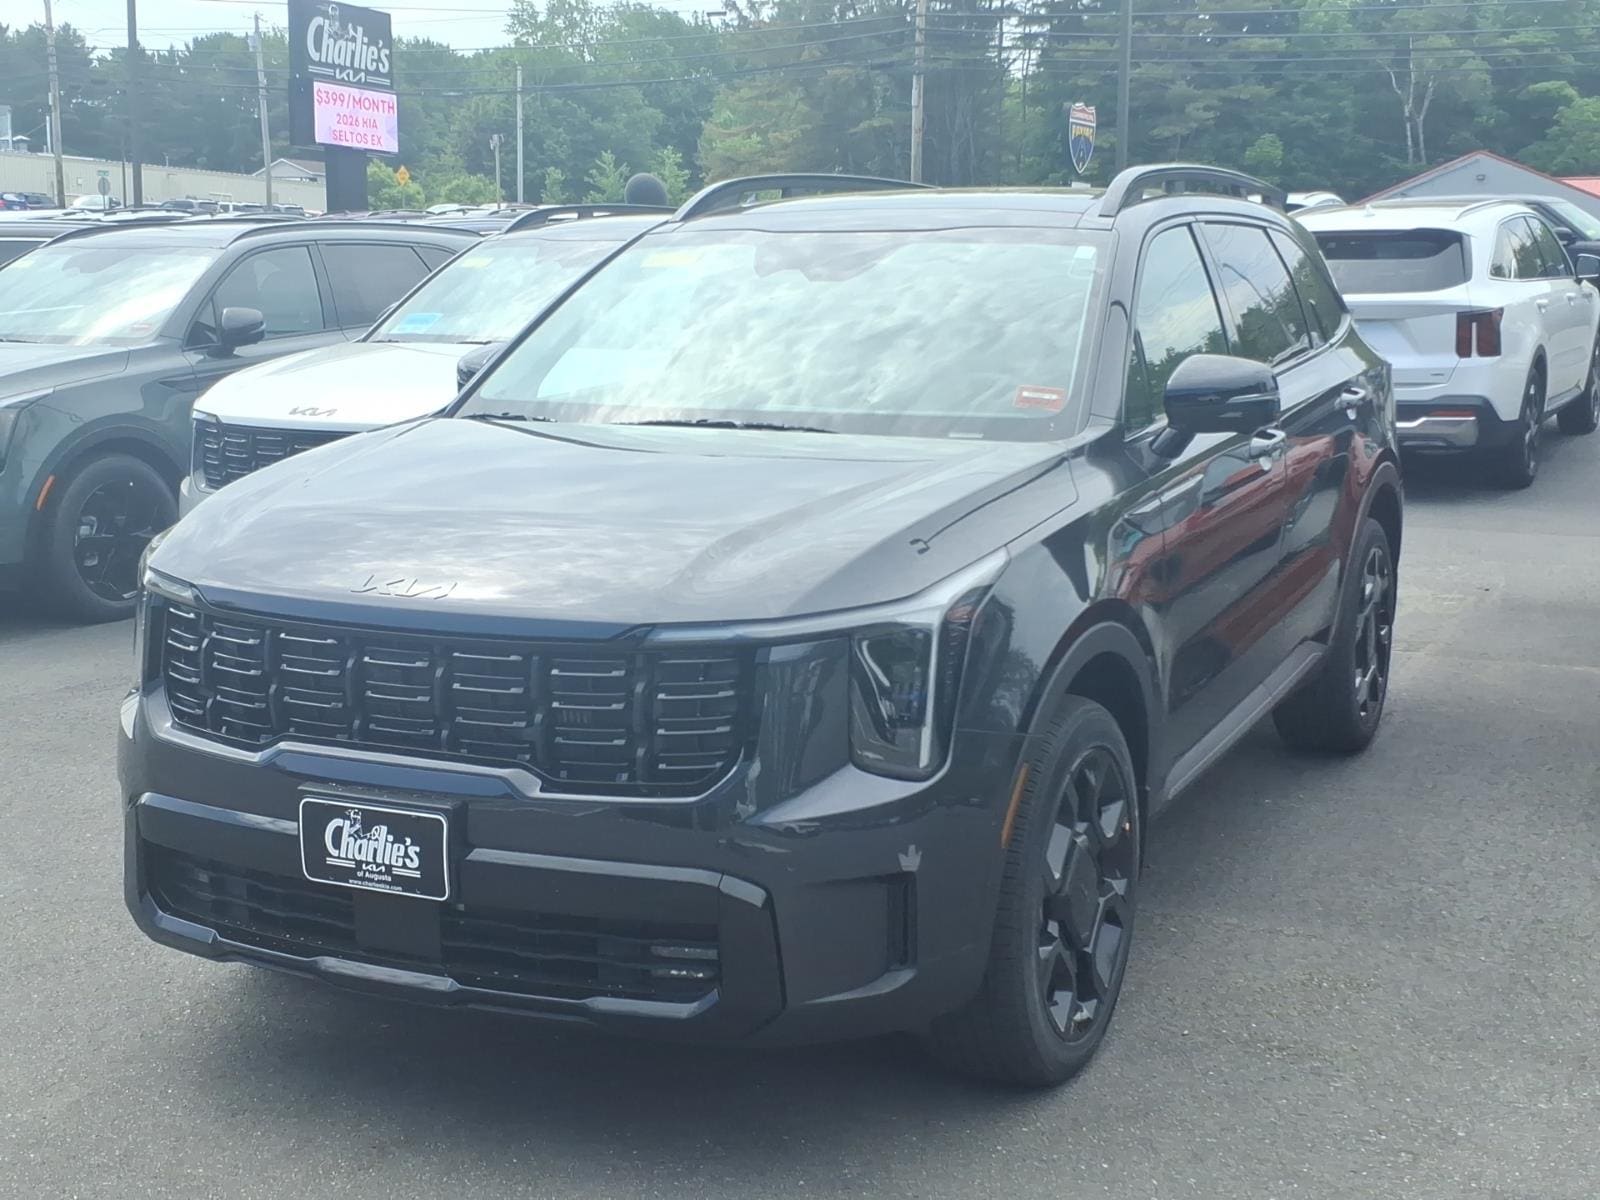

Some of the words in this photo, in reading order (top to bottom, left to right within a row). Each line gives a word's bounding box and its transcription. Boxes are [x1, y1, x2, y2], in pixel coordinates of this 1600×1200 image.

[307, 16, 390, 74] Charlie's
[316, 88, 396, 115] $399/MONTH
[336, 113, 360, 127] 2026
[332, 129, 369, 145] SELTOS
[371, 134, 383, 147] EX
[325, 818, 420, 868] Charlie's
[365, 871, 392, 882] Augusta
